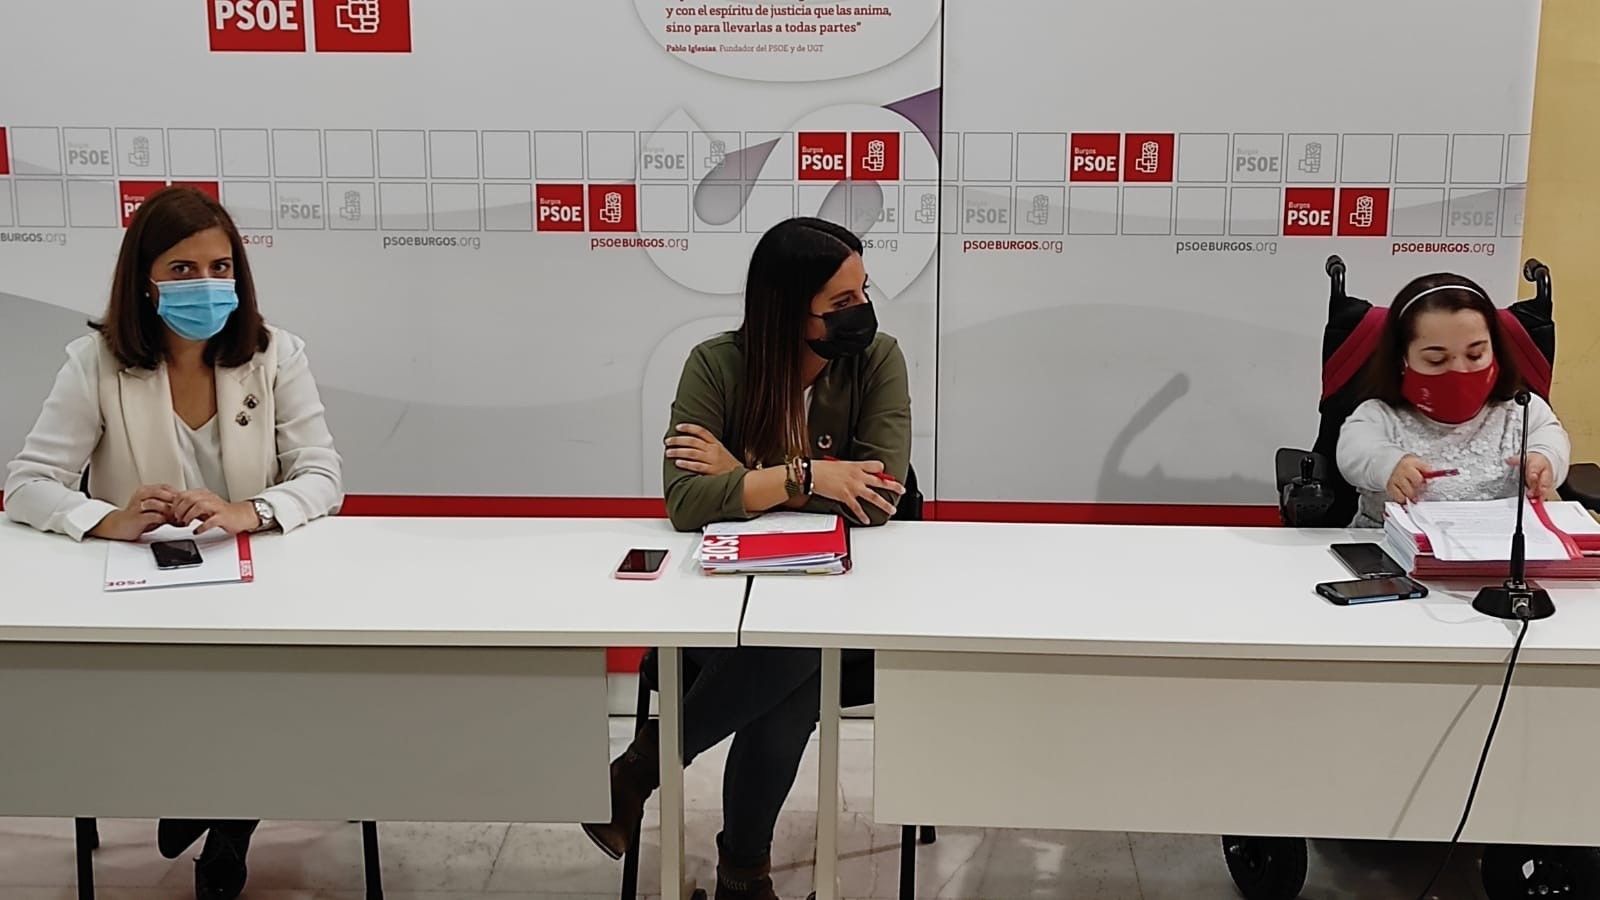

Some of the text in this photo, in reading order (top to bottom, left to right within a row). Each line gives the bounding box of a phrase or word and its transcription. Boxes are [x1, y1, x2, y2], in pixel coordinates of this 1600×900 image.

[214, 0, 298, 30] PSOE
[665, 4, 892, 19] y con el espíritu de justicia que las anima,
[665, 22, 692, 33] sino
[694, 24, 720, 36] para
[722, 21, 773, 33] llevarlas
[775, 24, 783, 33] a
[785, 21, 817, 33] todas
[666, 44, 687, 52] Pablo
[719, 44, 754, 52] Fundador
[755, 44, 767, 52] del
[768, 44, 789, 52] PSOE
[796, 44, 806, 52] de
[807, 44, 824, 52] UGT
[68, 150, 110, 165] PSOE
[643, 154, 685, 169] PSOE
[801, 154, 844, 170] PSOE
[1073, 156, 1116, 172] PSOE
[1236, 157, 1279, 172] PSOE
[280, 204, 321, 220] PSOE
[540, 206, 581, 222] PSOE
[965, 209, 1008, 223] PSOE
[1287, 210, 1330, 226] PSOE
[1451, 211, 1494, 226] PSOE
[0, 232, 66, 246] BURGOS.org
[591, 237, 688, 250] psoeBURGOS.org
[963, 239, 1063, 253] psoeBURGOS.org
[1392, 242, 1495, 256] psoeBURGOS.org
